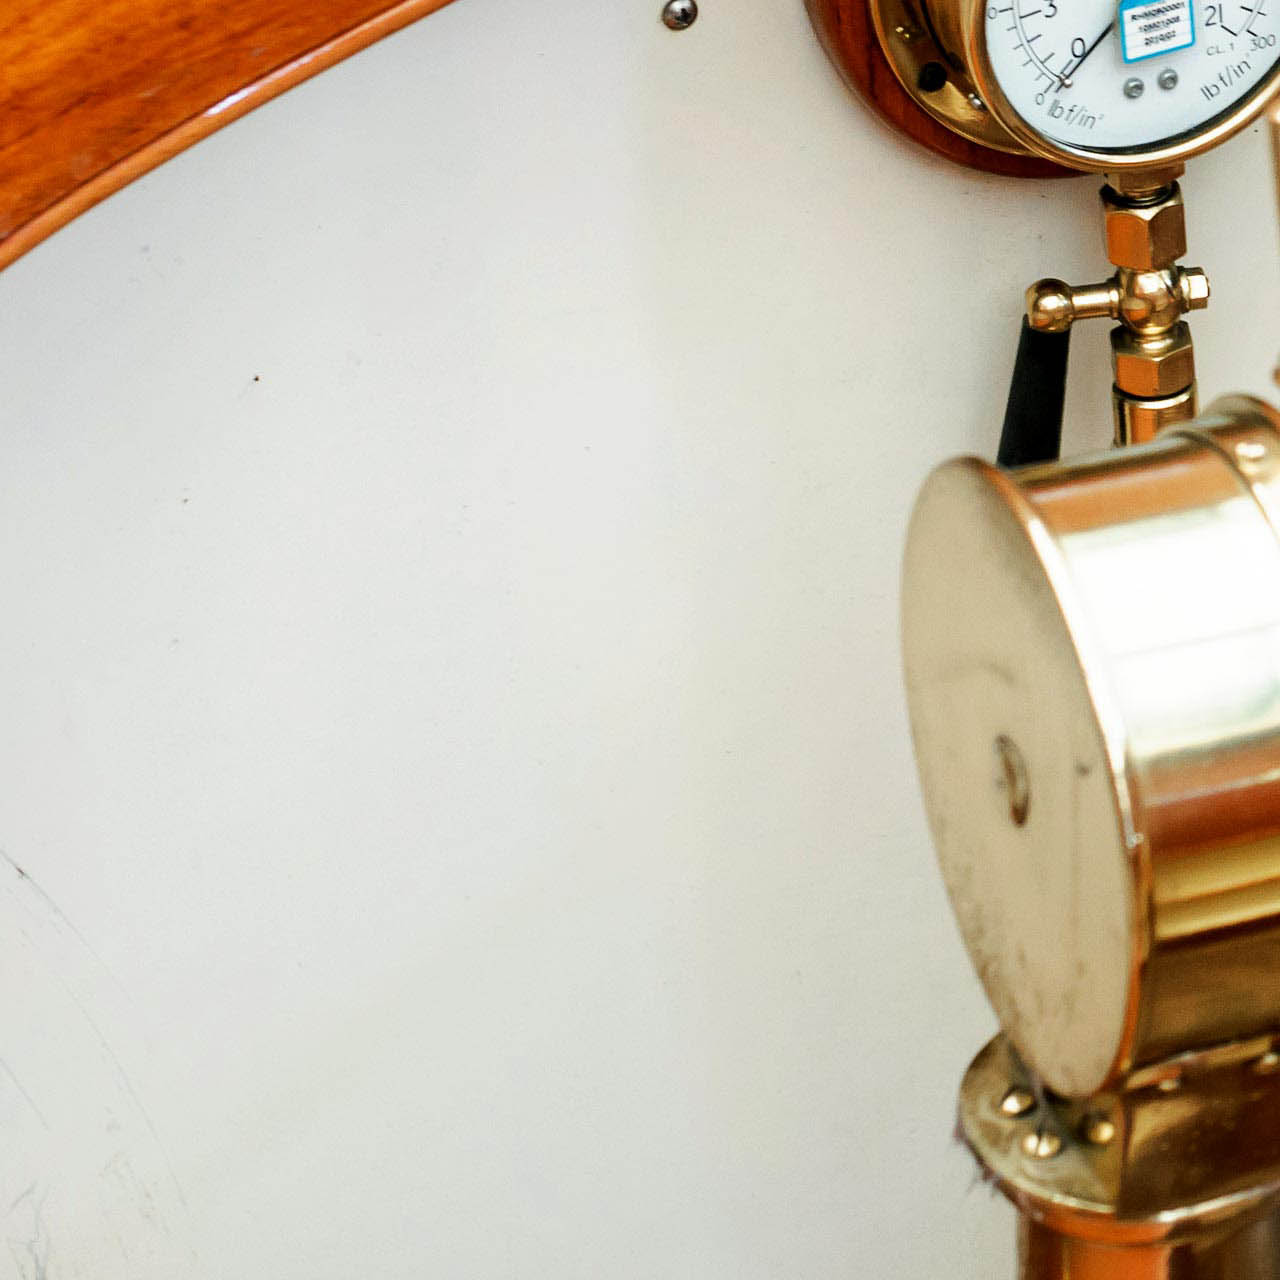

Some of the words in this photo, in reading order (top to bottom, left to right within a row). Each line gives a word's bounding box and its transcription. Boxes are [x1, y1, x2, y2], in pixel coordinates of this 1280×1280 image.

[1204, 3, 1223, 26] 21
[1071, 37, 1086, 58] 0
[1250, 34, 1276, 51] 300
[1035, 92, 1045, 106] 0
